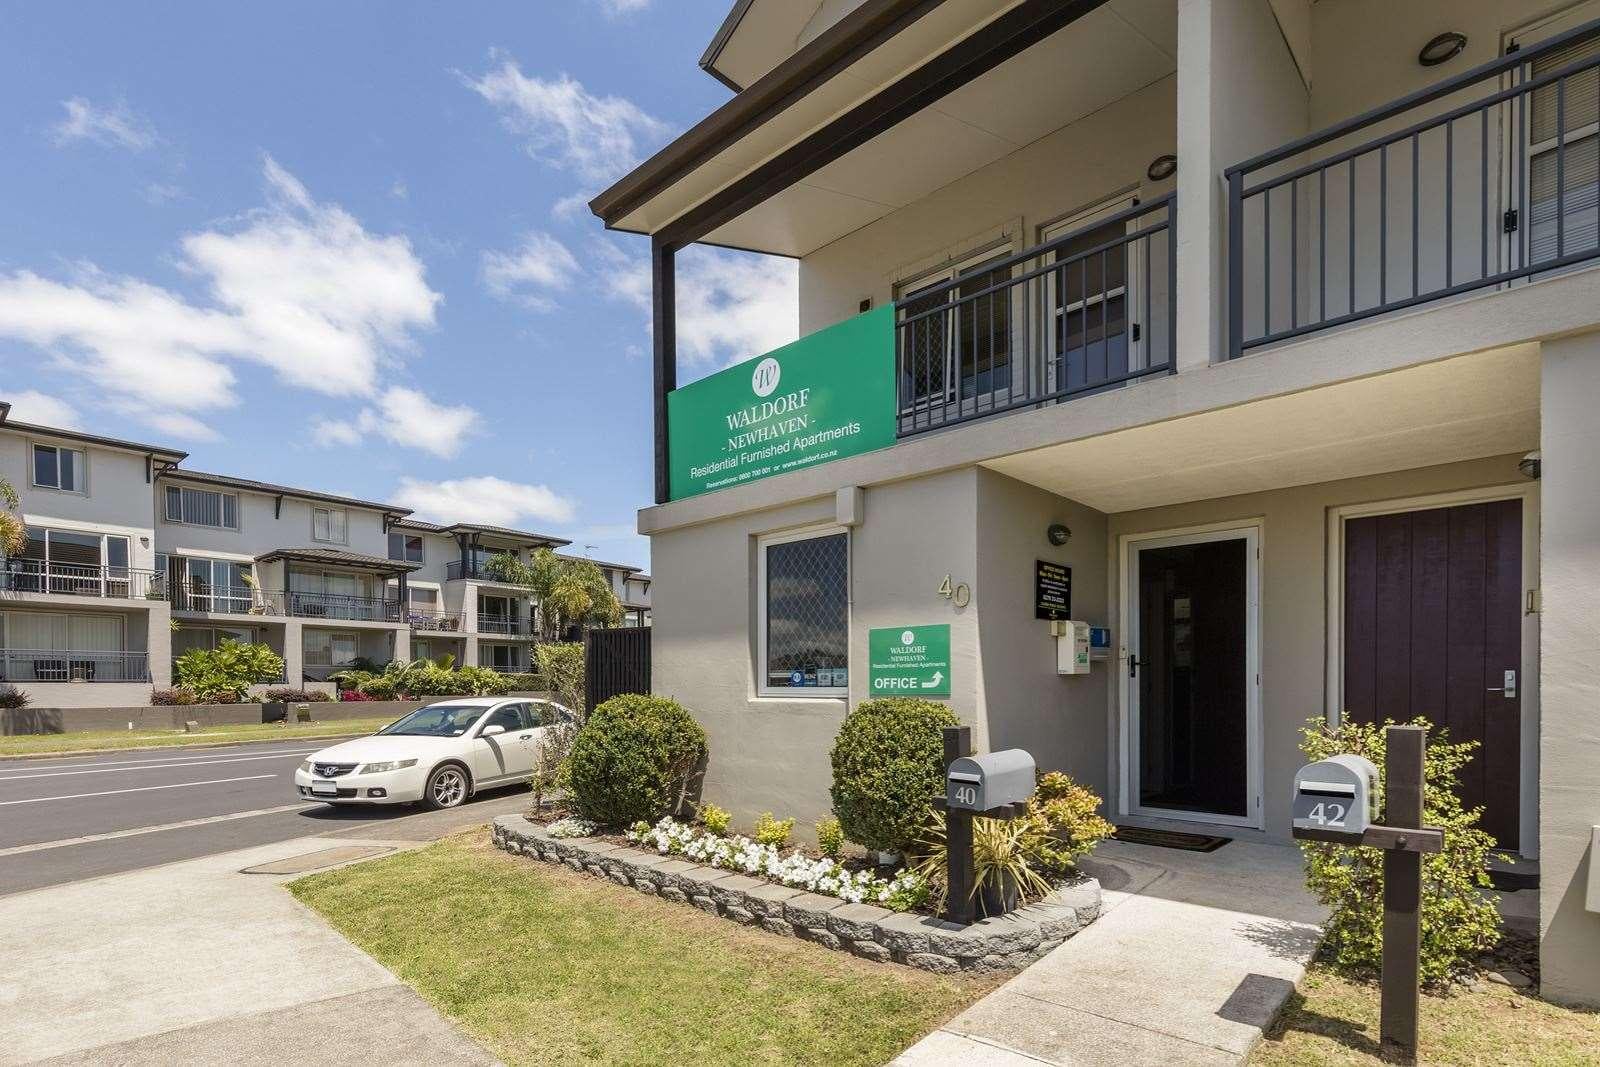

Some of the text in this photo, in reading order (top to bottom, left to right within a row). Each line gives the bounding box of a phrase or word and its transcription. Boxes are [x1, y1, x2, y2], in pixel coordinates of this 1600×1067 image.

[726, 388, 810, 430] WALDORF
[690, 422, 861, 479] Residential Furnished Apartments
[938, 574, 971, 608] 40
[890, 645, 928, 654] WALDORF
[874, 677, 917, 689] OFFICE
[955, 787, 976, 805] 40
[1308, 803, 1345, 827] 42
